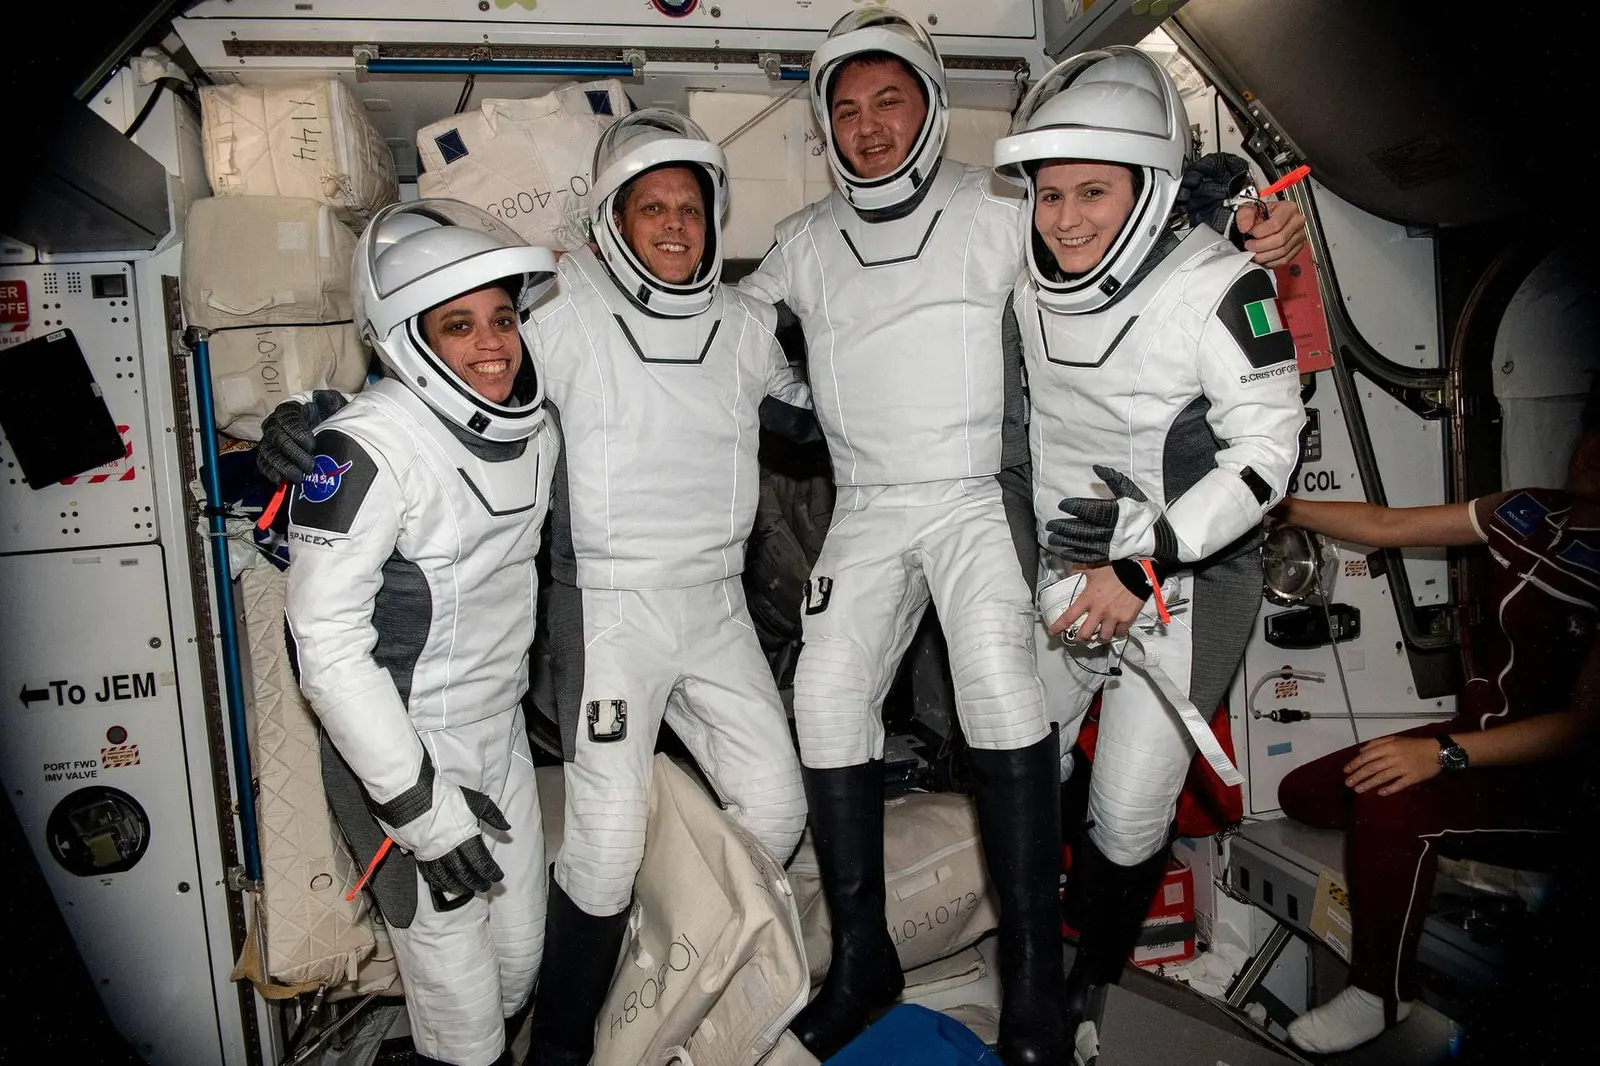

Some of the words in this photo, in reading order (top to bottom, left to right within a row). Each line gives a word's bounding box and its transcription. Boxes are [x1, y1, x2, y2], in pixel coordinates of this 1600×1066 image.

[288, 99, 322, 162] 1144
[302, 472, 336, 487] NASA
[1304, 470, 1342, 493] COL
[289, 531, 351, 548] SPACEX
[49, 680, 86, 706] To
[95, 672, 157, 703] JEM
[43, 762, 71, 771] PORT
[74, 760, 97, 769] FWD
[45, 774, 63, 782] IMV
[66, 770, 98, 780] VALVE
[892, 891, 979, 946] 1.0-1073
